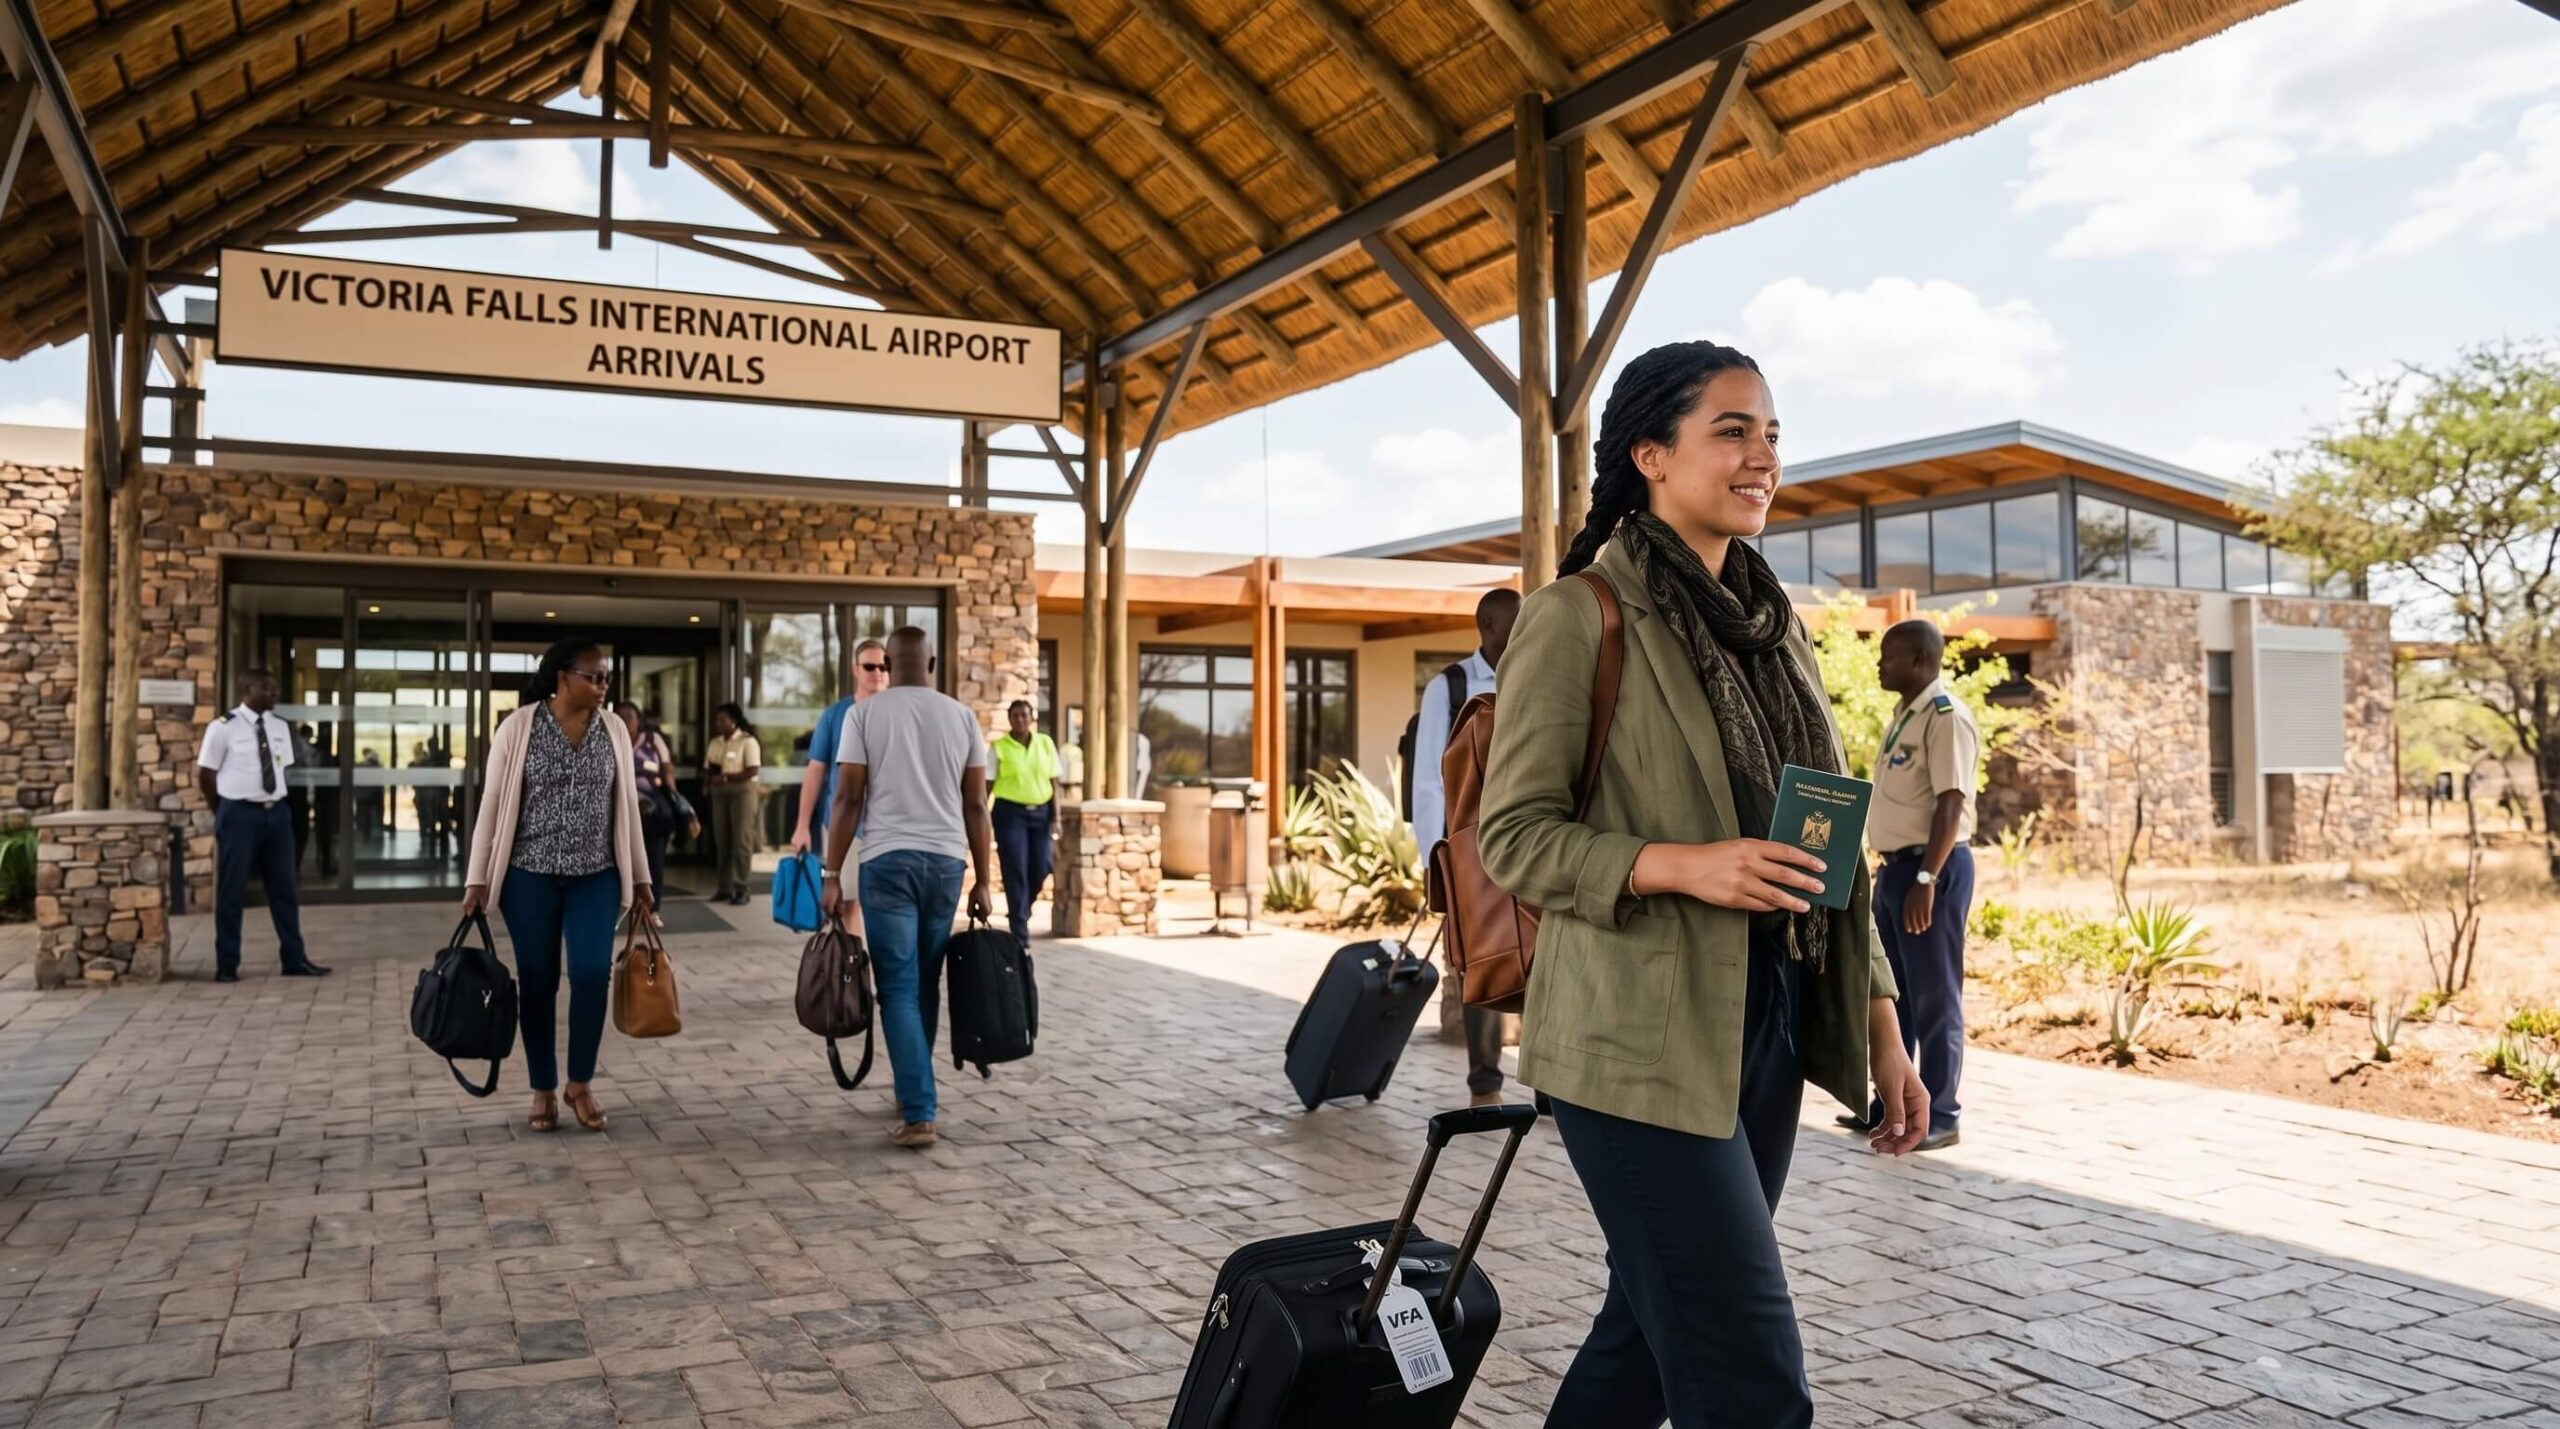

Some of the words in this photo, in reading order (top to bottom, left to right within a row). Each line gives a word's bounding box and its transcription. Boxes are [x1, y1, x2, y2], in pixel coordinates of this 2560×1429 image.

[260, 267, 454, 315] VICTORIA
[465, 286, 578, 326] FALLS
[590, 298, 878, 352] INTERNATIONAL
[887, 326, 1031, 365] AIRPORT
[587, 343, 766, 385] ARRIVALS
[1387, 1308, 1423, 1328] VFA
